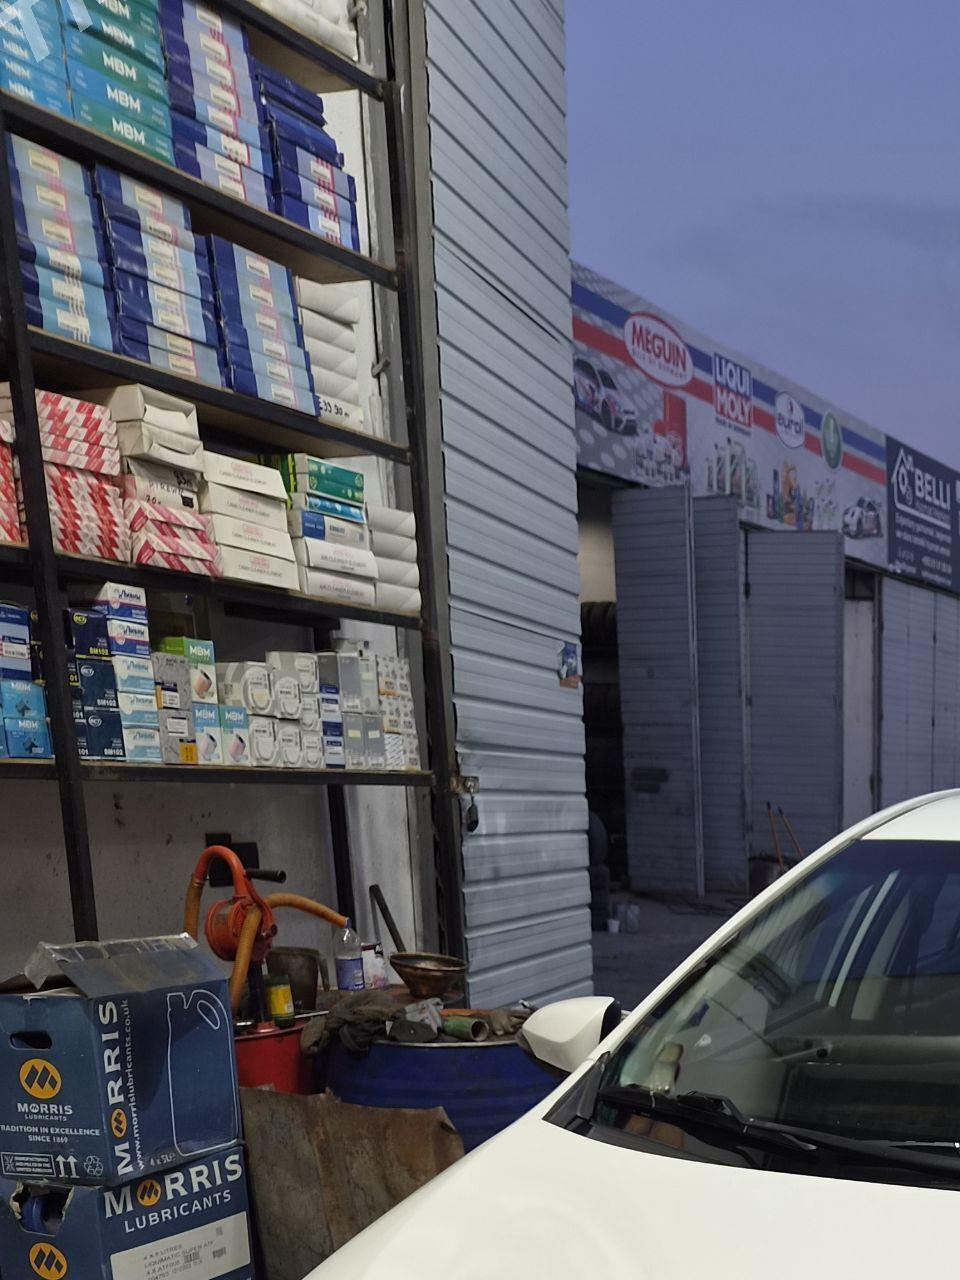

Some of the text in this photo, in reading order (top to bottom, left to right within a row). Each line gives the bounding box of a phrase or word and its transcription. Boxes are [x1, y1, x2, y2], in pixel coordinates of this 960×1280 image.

[102, 51, 137, 81] MBM
[106, 83, 141, 113] MBM
[112, 117, 146, 145] MBM
[716, 356, 751, 396] LIQUI
[716, 387, 752, 425] MOLY
[189, 645, 210, 657] MBM
[195, 709, 216, 719] MBM
[225, 711, 244, 721] MBM
[99, 1000, 134, 1177] MORRIS
[121, 999, 145, 1171] www.morrislubricants.co.uk
[17, 1102, 74, 1115] MORRIS
[25, 1113, 68, 1121] LUBRICANTS
[28, 1134, 51, 1143] SINCE
[40, 1126, 50, 1134] IN
[50, 1126, 101, 1136] EXCELLENCE
[104, 1153, 243, 1219] MORRIS
[124, 1189, 232, 1234] LUBRICANTS
